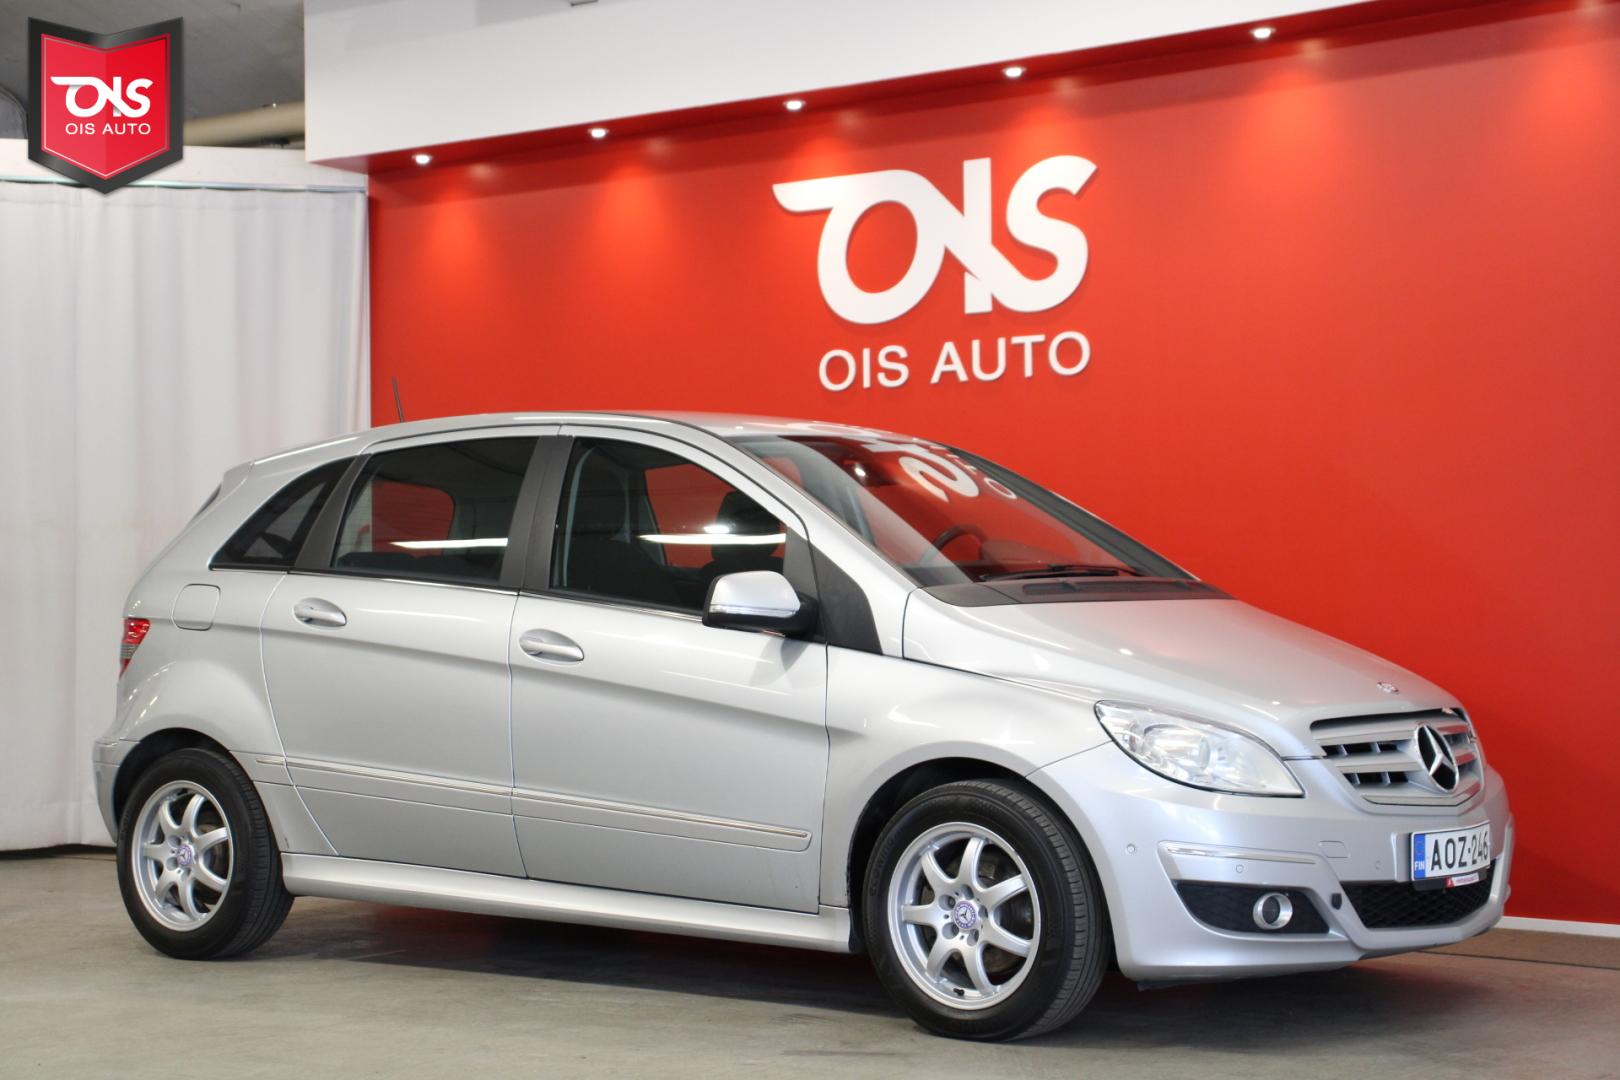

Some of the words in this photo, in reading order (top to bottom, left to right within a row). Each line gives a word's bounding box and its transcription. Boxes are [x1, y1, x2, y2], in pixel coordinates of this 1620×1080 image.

[819, 345, 909, 391] OIS
[930, 331, 1090, 384] AUTO
[1414, 861, 1425, 871] FIN
[1430, 831, 1488, 871] AOZ-246
